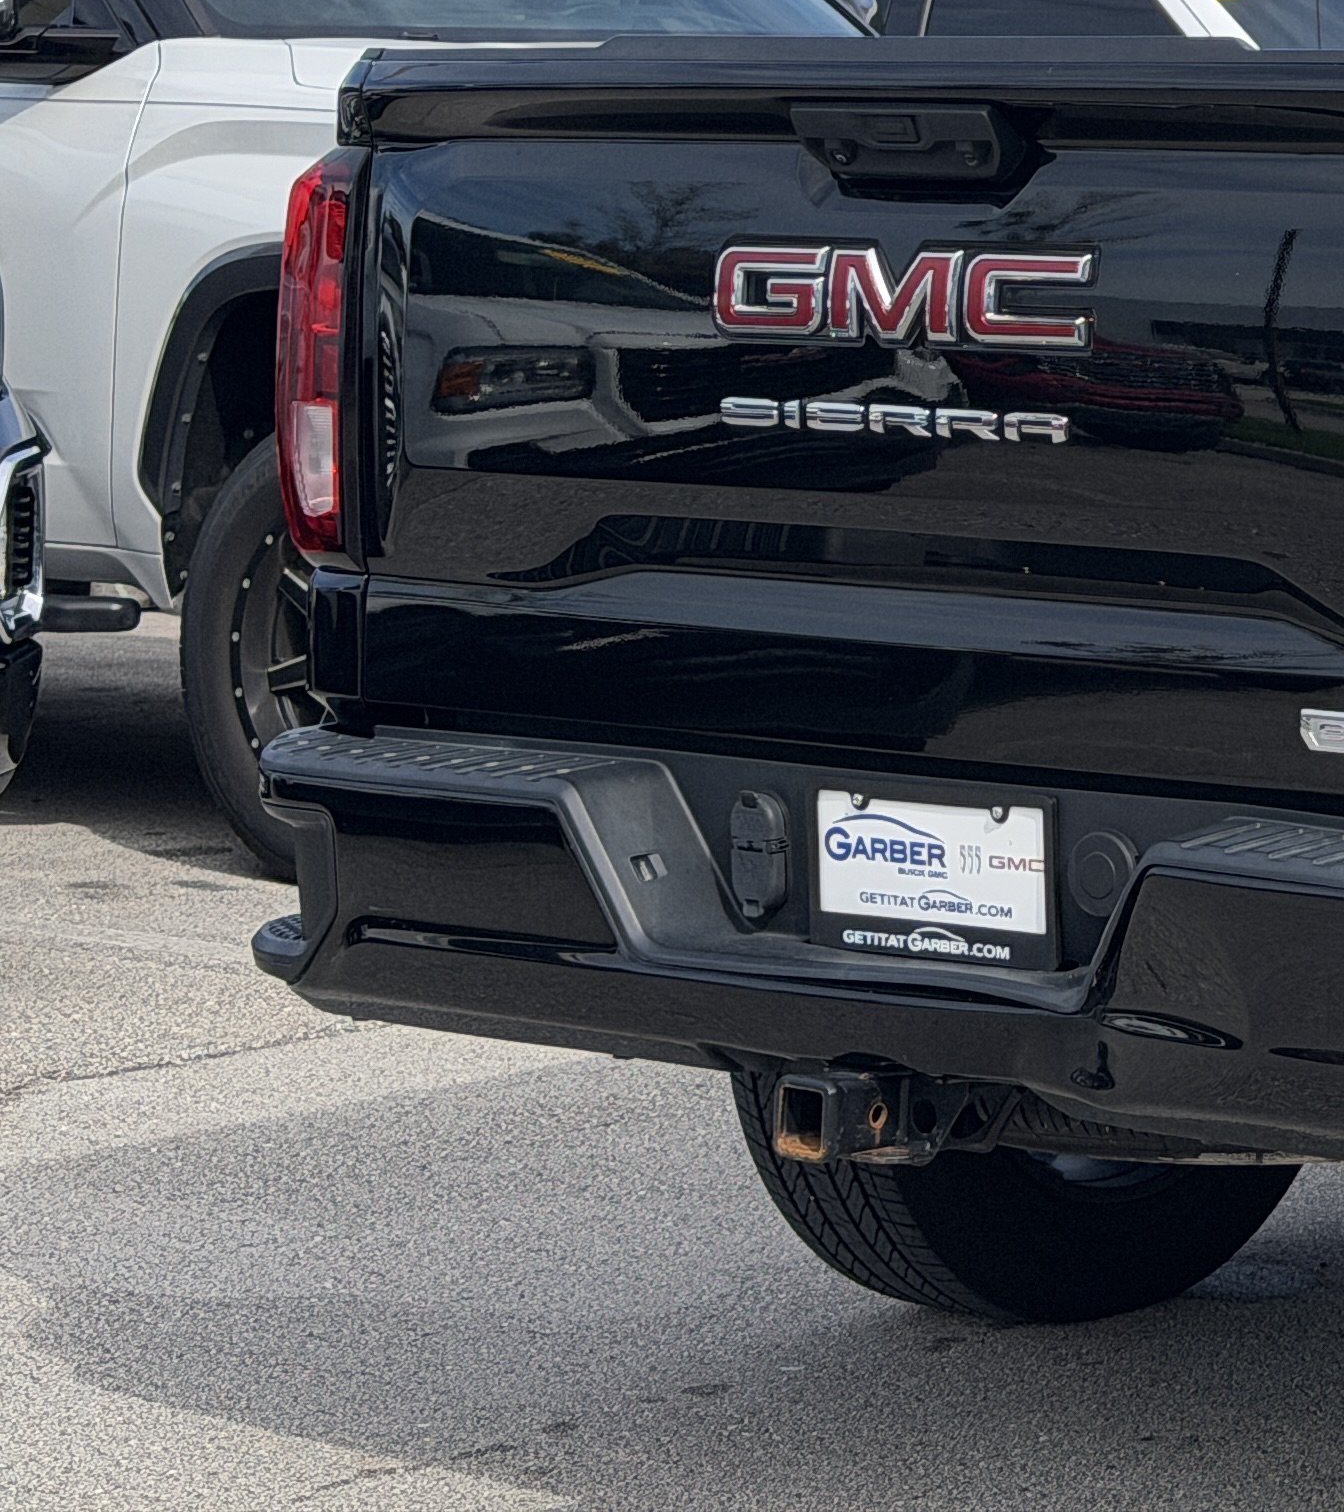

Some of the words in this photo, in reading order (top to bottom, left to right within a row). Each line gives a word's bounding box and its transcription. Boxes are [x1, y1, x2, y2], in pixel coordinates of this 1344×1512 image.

[714, 245, 1093, 348] GMC
[720, 396, 1070, 444] SIERRA
[825, 826, 946, 868] GARBER
[988, 855, 1045, 873] GMC
